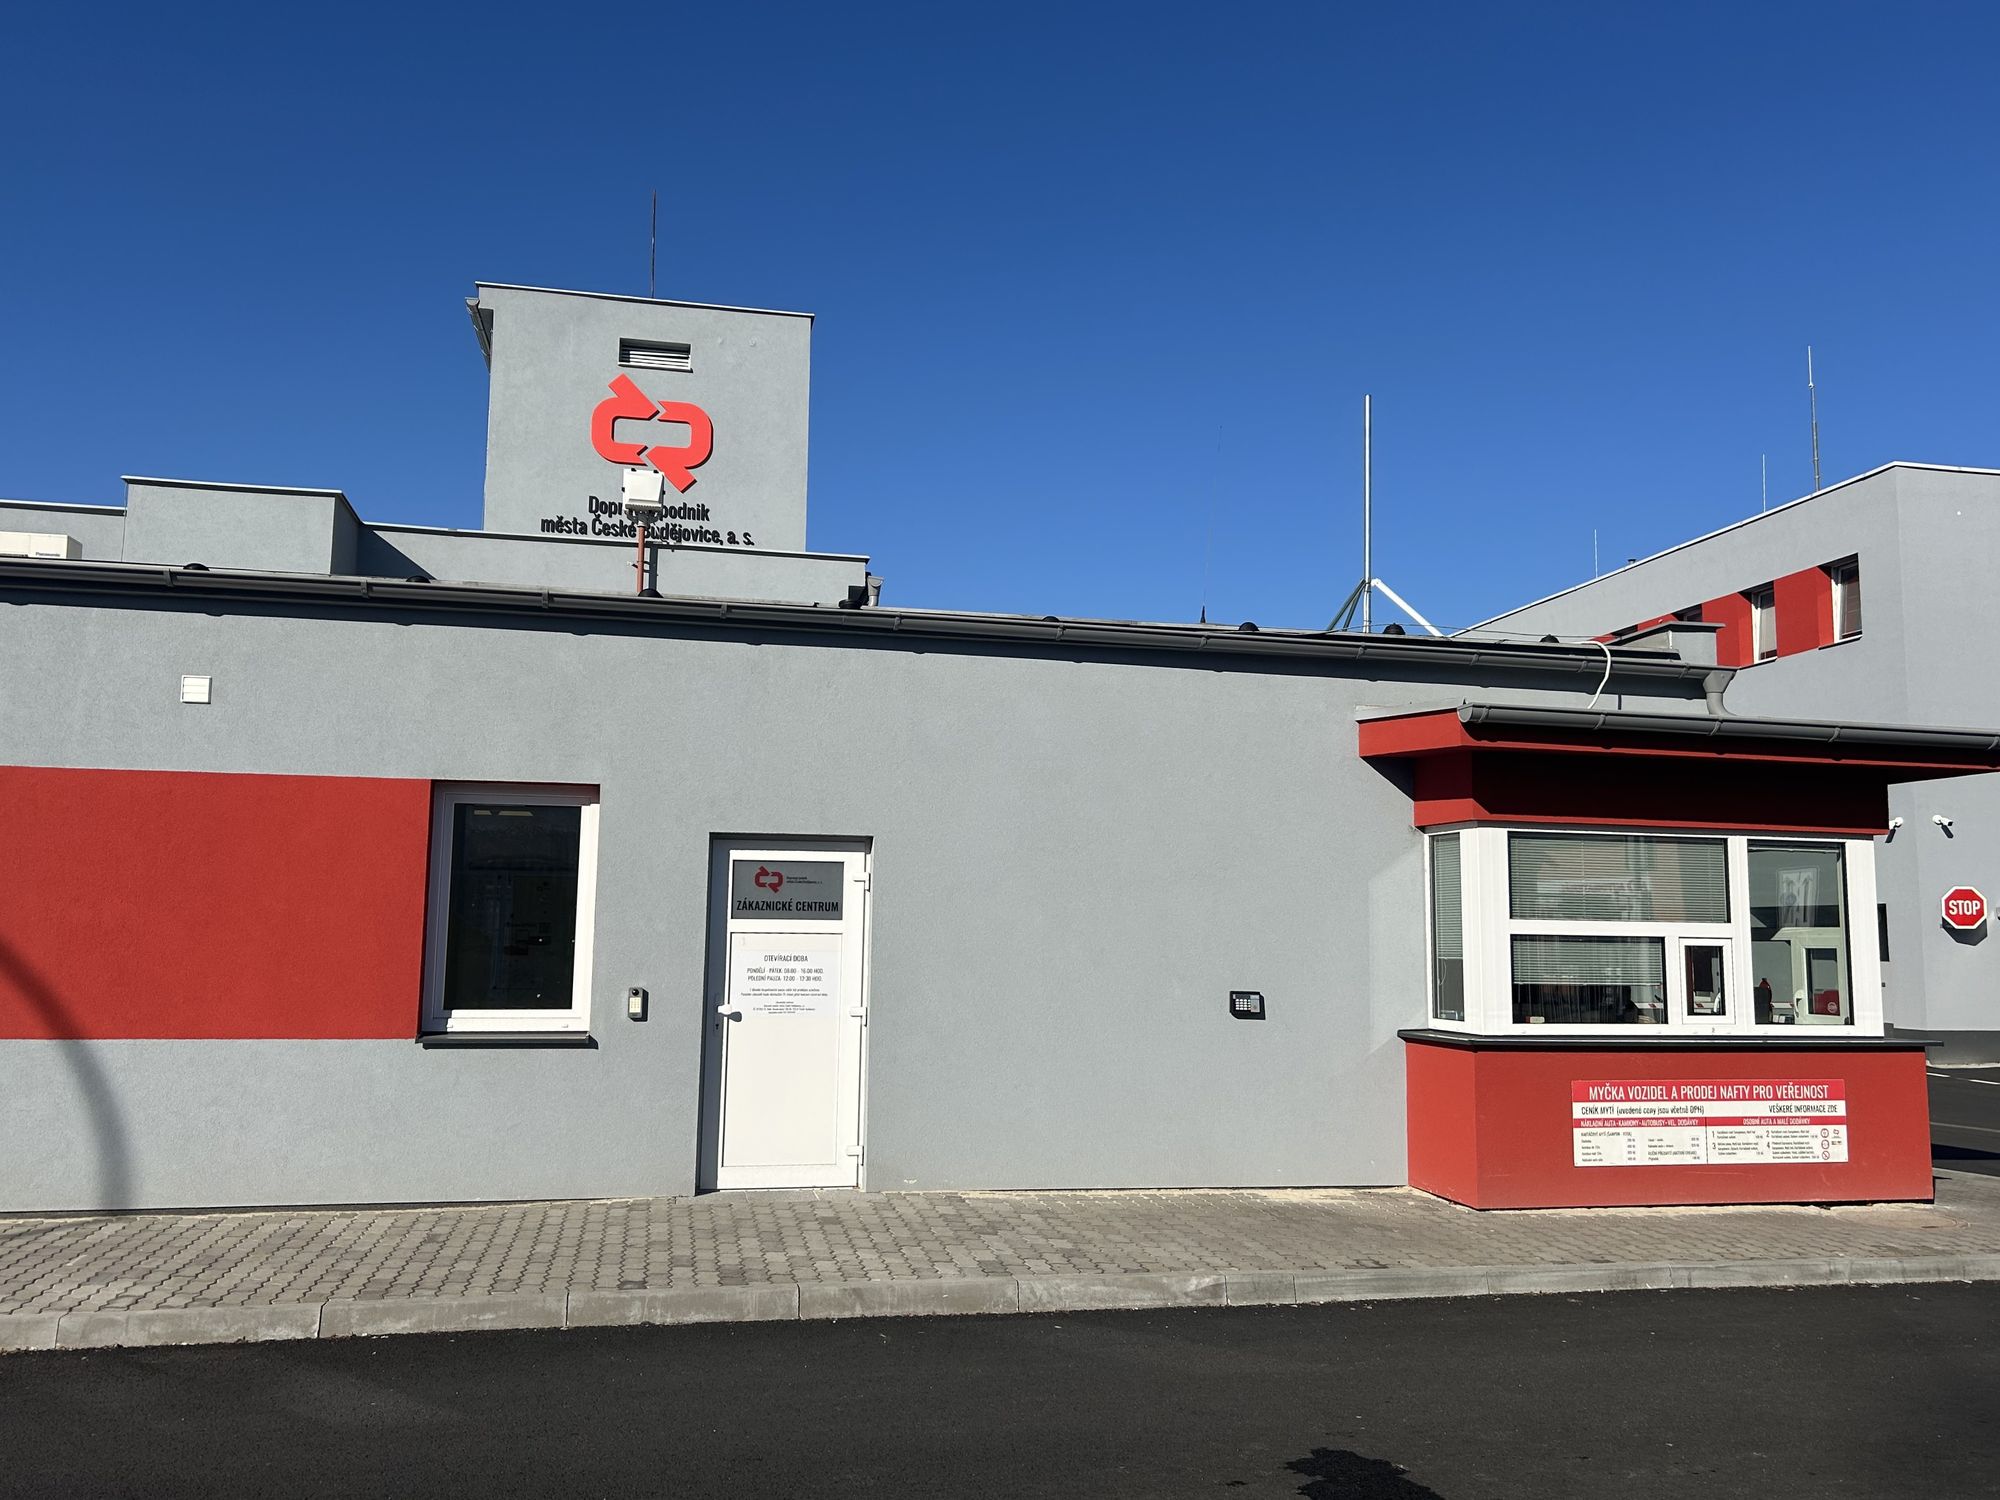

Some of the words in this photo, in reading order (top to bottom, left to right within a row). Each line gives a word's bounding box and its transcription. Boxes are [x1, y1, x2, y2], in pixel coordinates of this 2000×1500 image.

[660, 502, 711, 522] podnik
[540, 515, 588, 535] města
[592, 512, 637, 538] České
[727, 530, 740, 545] a.
[743, 531, 755, 546] s.
[736, 897, 793, 911] ZÁKAZNICKÉ
[796, 901, 839, 912] CENTRUM
[1948, 899, 1981, 916] STOP
[764, 953, 792, 962] OTEVÍRACÍ
[793, 954, 809, 962] DOBA
[1589, 1083, 1625, 1101] MYČKA
[1627, 1086, 1668, 1100] VOZIDEL
[1671, 1086, 1678, 1100] A
[1680, 1085, 1717, 1100] PRODEJ
[1720, 1085, 1750, 1099] NAFTY
[1753, 1085, 1773, 1099] PRO
[1775, 1082, 1829, 1099] VEŘEJNOST
[1581, 1104, 1599, 1115] CENÍK
[1600, 1104, 1615, 1115] MYTÍ
[1657, 1106, 1669, 1115] jsou
[1768, 1103, 1793, 1113] VEŠKERÉ
[1794, 1104, 1826, 1113] INFORMACE
[1827, 1104, 1838, 1113] ZDE
[1765, 1130, 1770, 1138] 2
